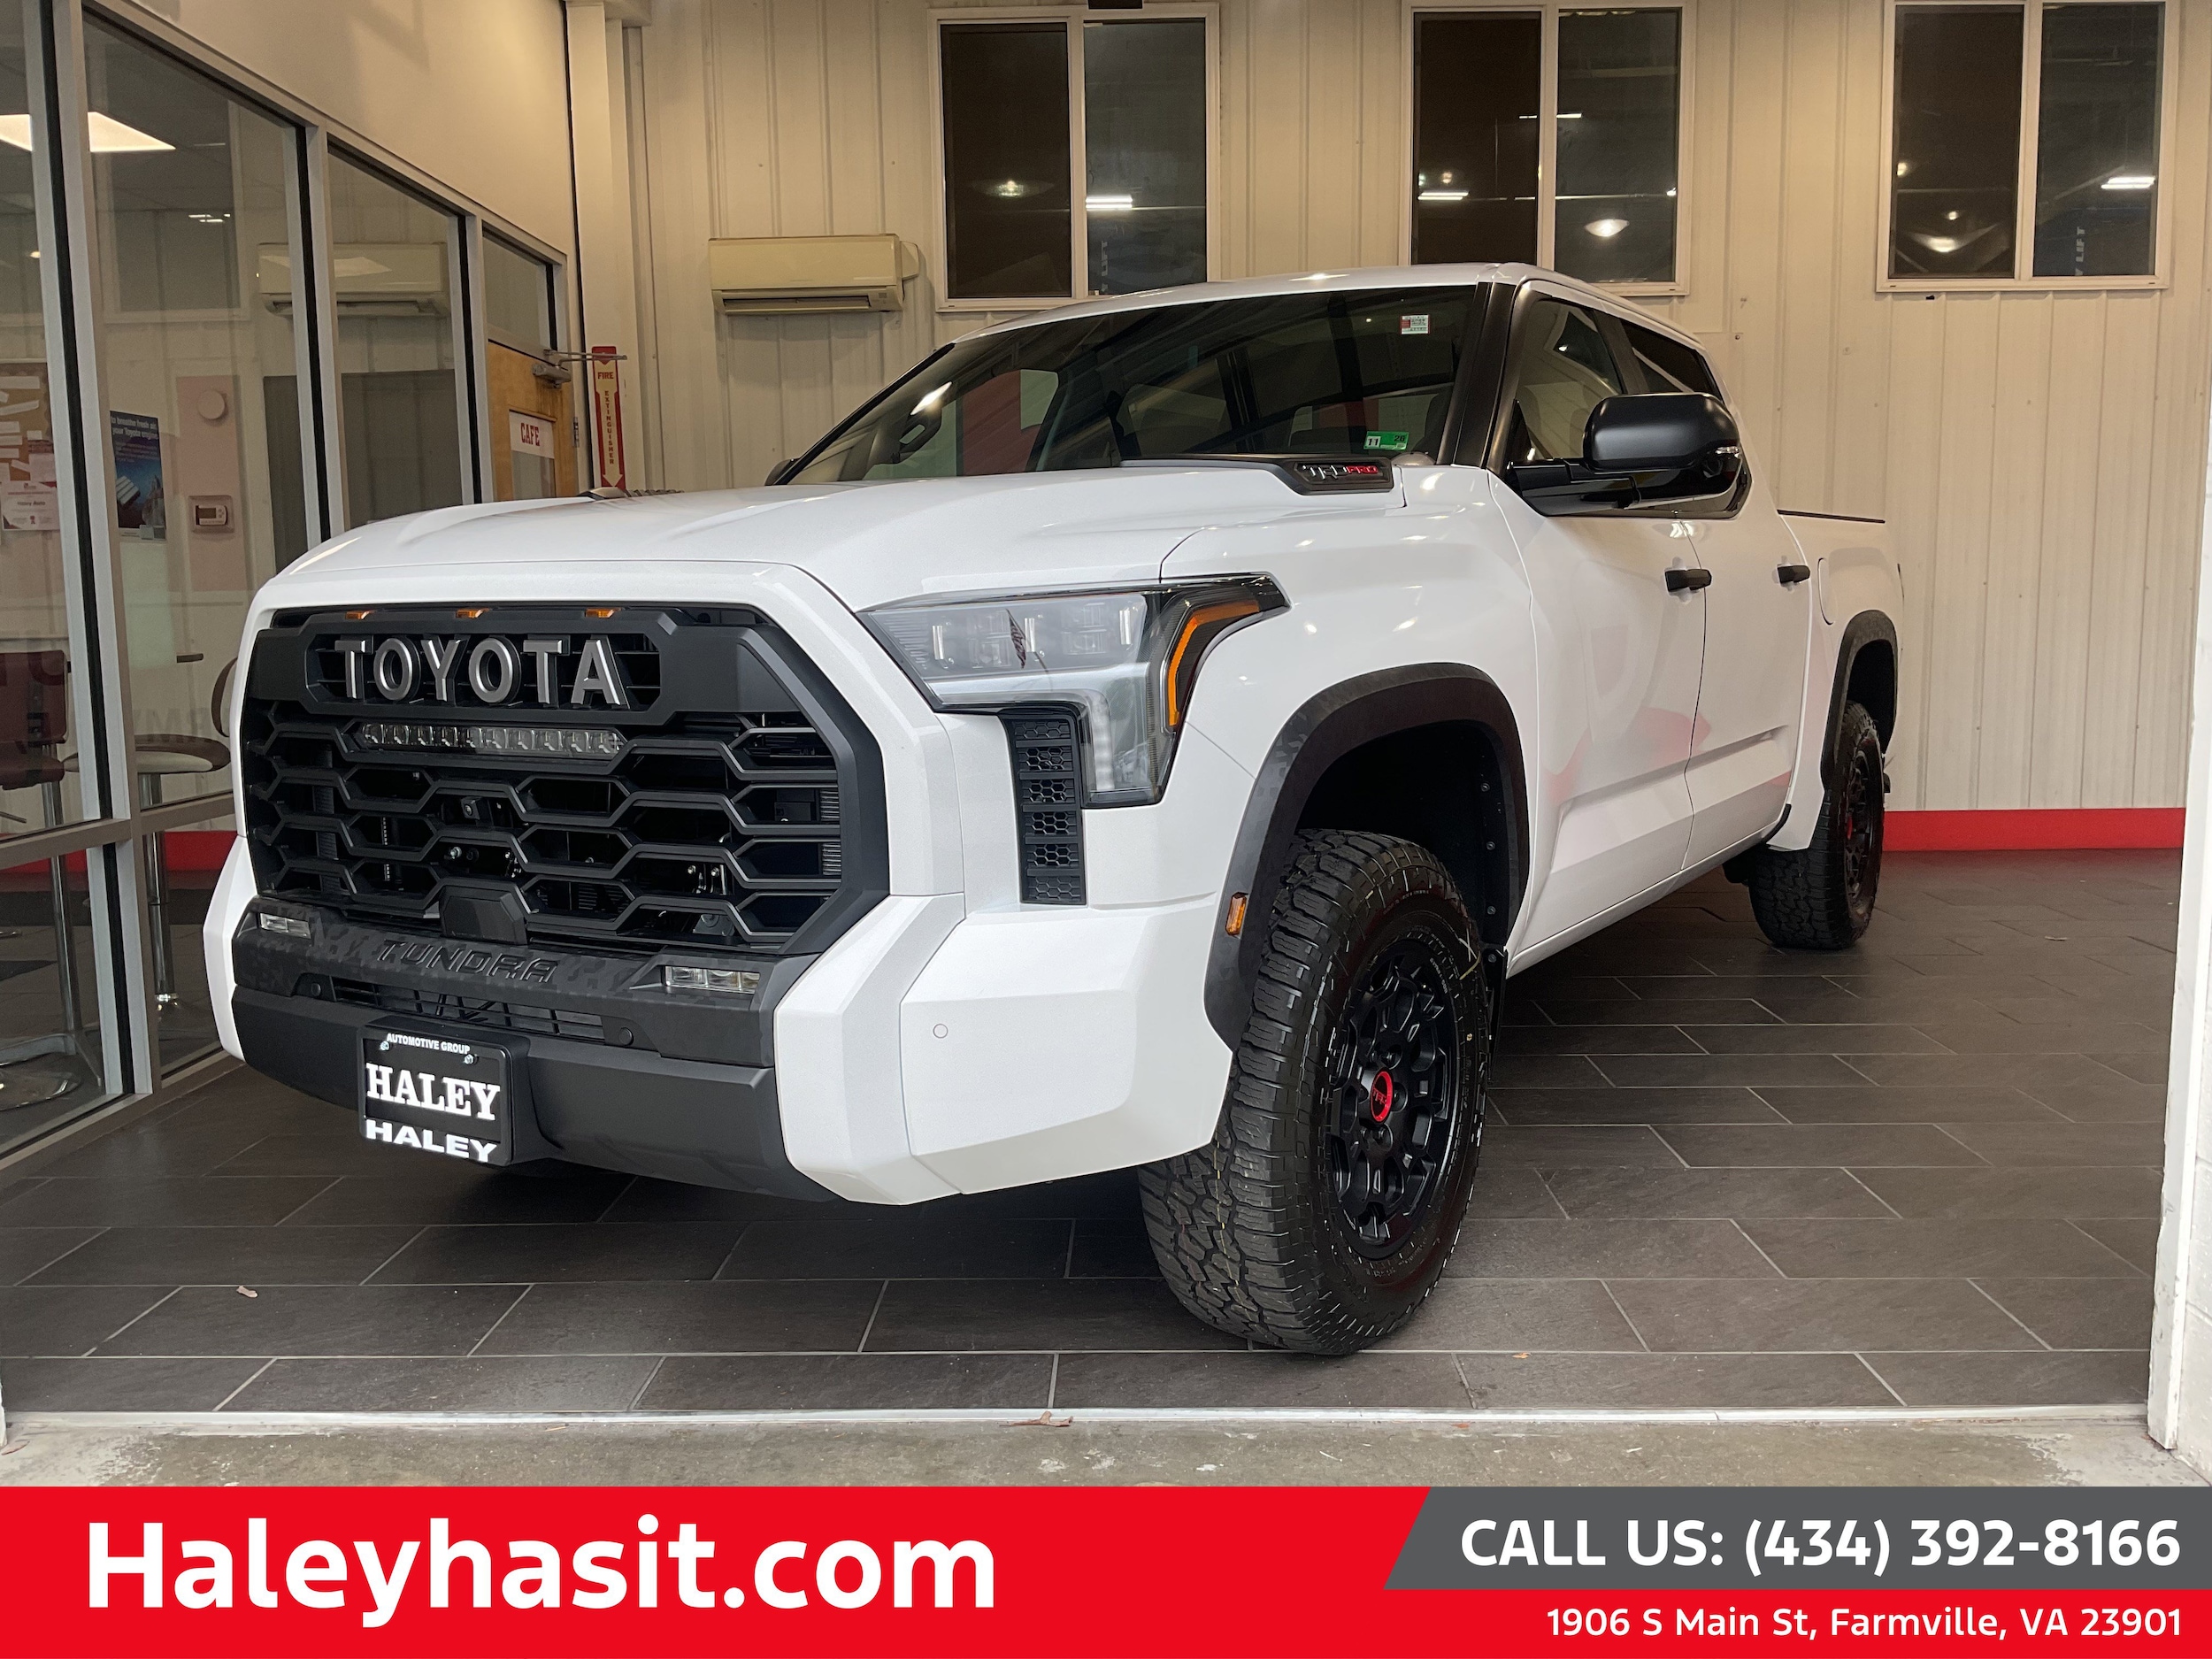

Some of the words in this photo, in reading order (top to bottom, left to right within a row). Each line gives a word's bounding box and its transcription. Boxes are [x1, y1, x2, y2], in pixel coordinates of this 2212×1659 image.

[519, 422, 541, 447] CAFE
[604, 390, 614, 465] EXTINGUISHER
[1367, 437, 1379, 446] 11
[334, 636, 625, 708] TOYOTA
[376, 938, 561, 983] TUNDRA
[386, 1033, 440, 1051] AUTOMOTIVE
[440, 1041, 471, 1055] GROUP
[365, 1062, 501, 1121] HALEY
[365, 1119, 497, 1163] HALEY
